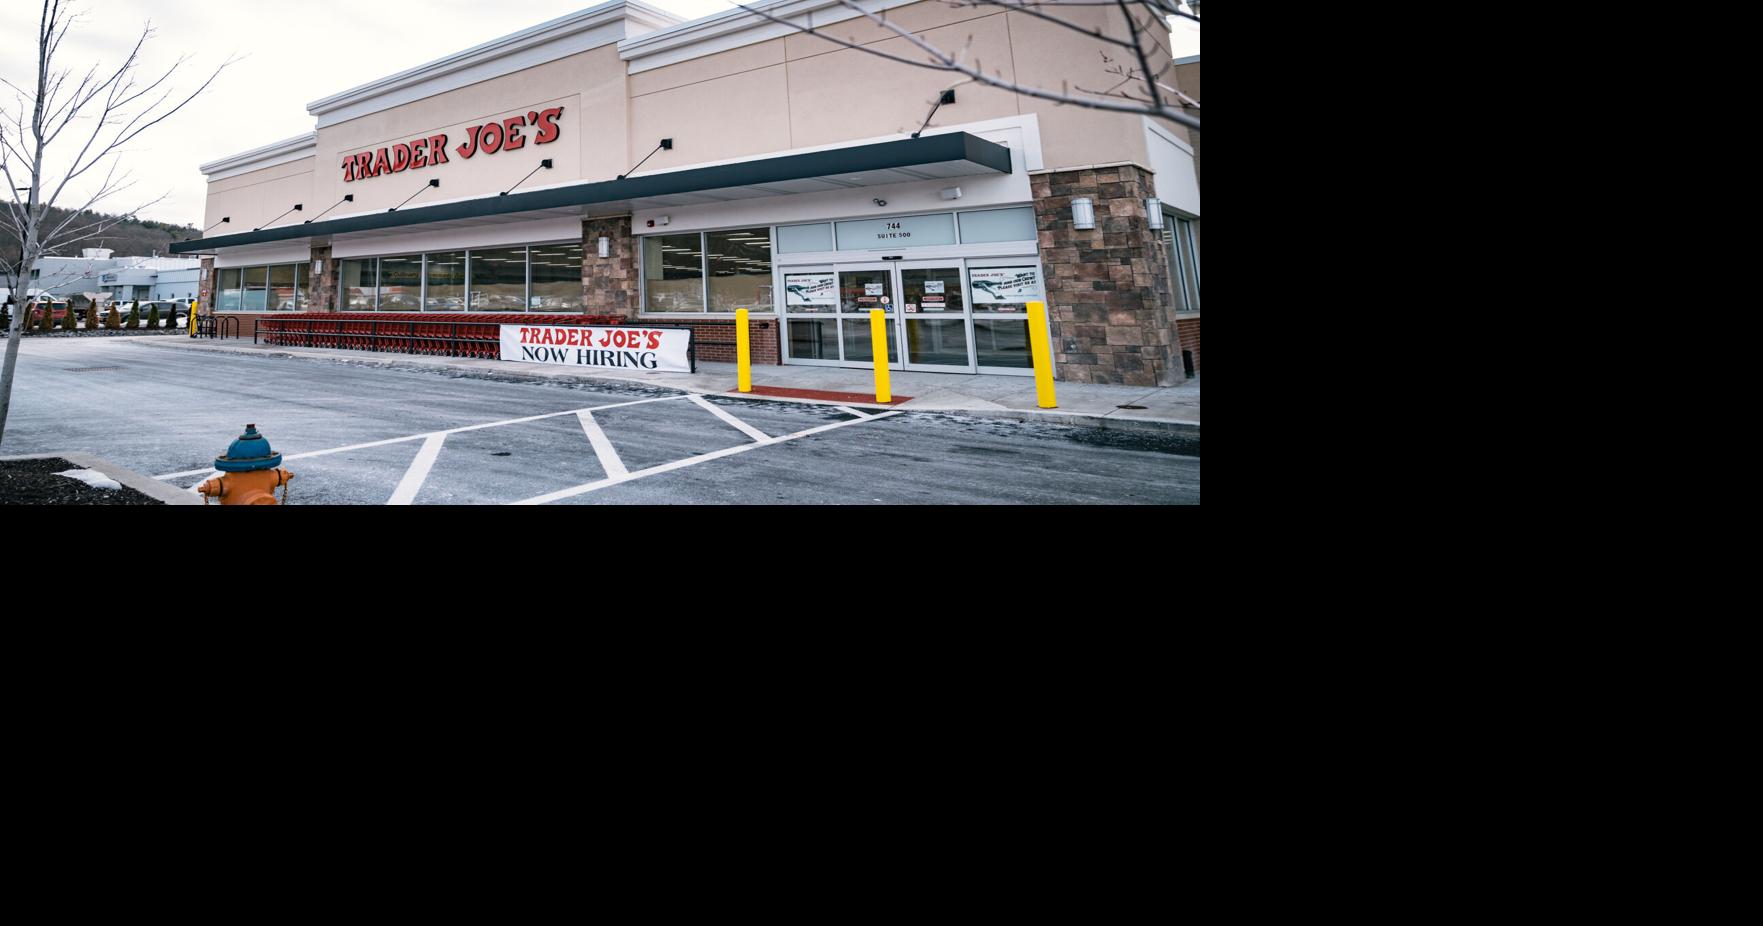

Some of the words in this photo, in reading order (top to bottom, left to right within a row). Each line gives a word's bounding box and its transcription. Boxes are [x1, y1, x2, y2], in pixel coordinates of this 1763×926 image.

[342, 134, 449, 182] TRADER
[456, 107, 564, 159] JOE'S
[887, 222, 901, 230] 744
[520, 328, 593, 347] TRADER
[598, 330, 663, 349] JOE'S
[522, 346, 568, 363] NOW
[577, 349, 658, 369] HIRING
